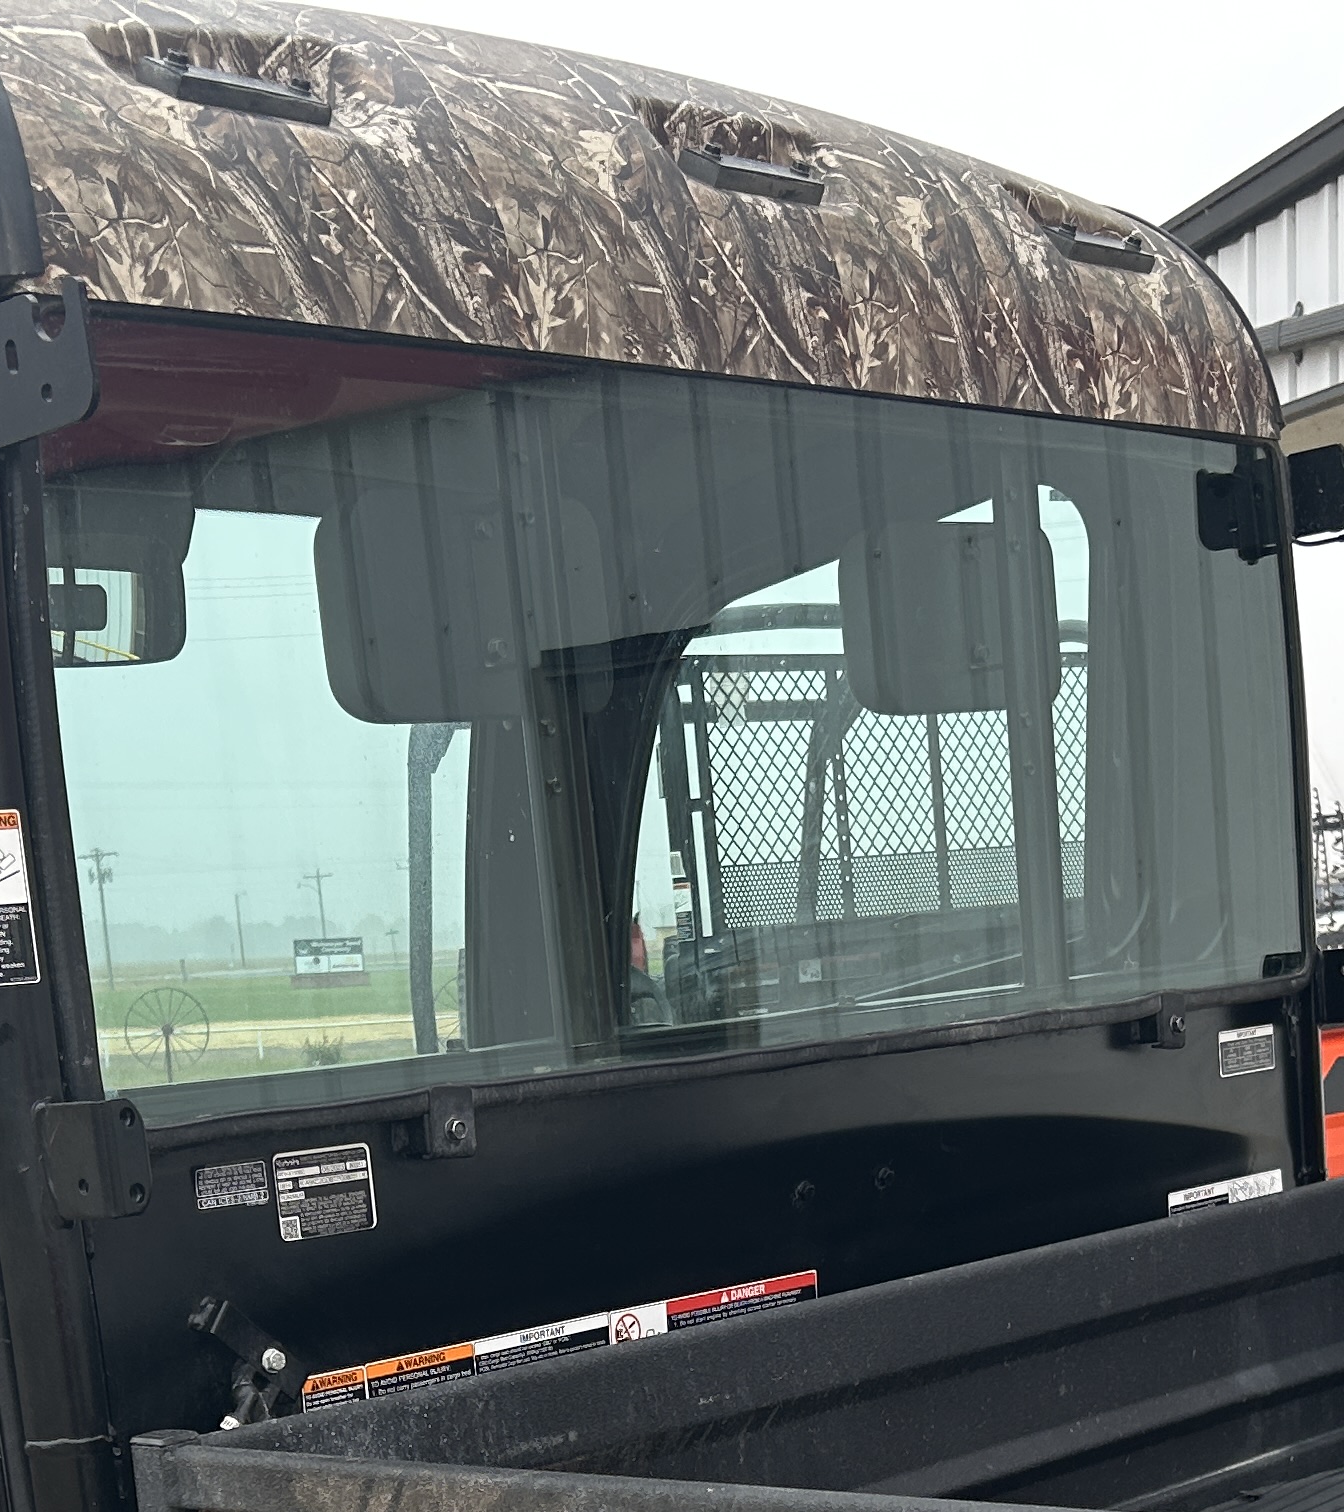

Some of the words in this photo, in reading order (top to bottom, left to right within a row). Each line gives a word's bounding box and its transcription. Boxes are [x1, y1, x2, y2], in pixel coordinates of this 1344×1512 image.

[730, 1284, 766, 1301] DANGER
[520, 1326, 565, 1343] IMPORTANT
[404, 1352, 445, 1369] WARNING
[318, 1372, 357, 1388] WARNING
